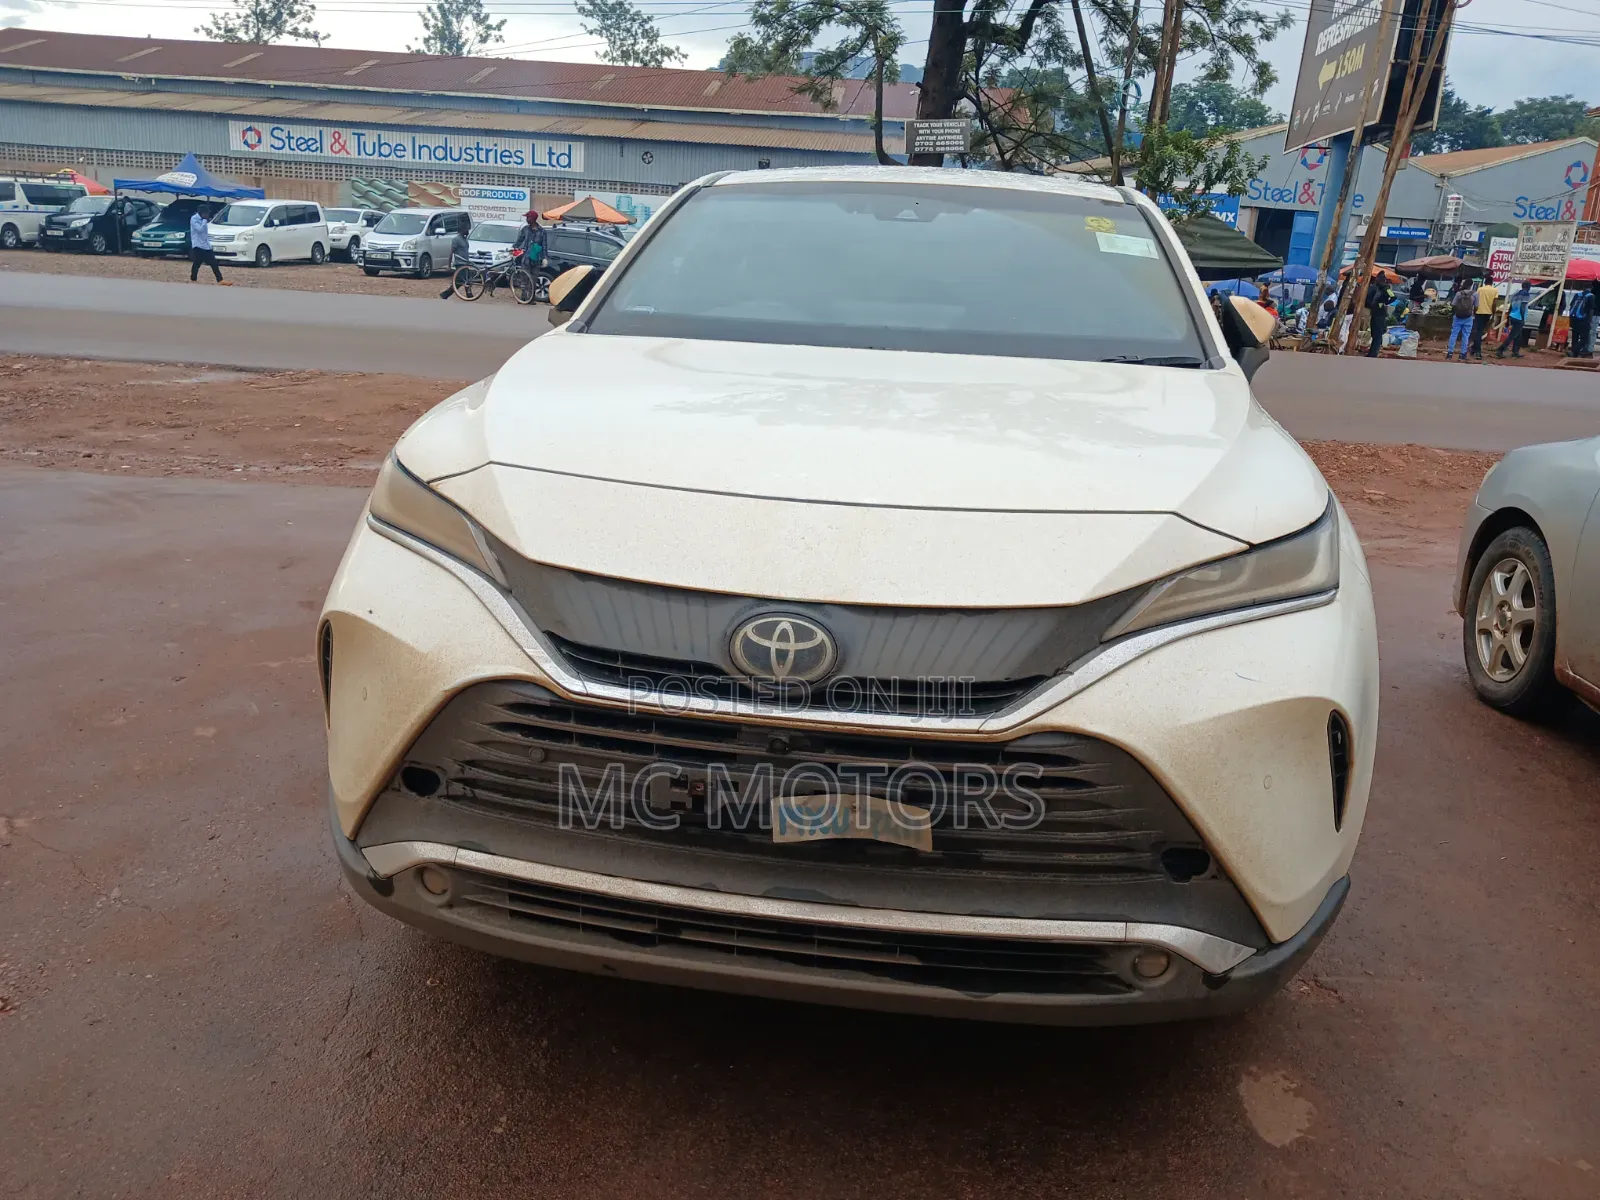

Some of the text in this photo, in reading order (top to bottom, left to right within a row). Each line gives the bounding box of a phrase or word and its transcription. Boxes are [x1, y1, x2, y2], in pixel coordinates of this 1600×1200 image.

[270, 126, 572, 169] Steel & Tube Industries Ltd
[458, 188, 524, 200] ROOF PRODUCTS
[1247, 178, 1299, 204] Steel
[1298, 182, 1317, 206] &
[1512, 196, 1562, 221] Steel
[1492, 262, 1511, 271] ENGI
[1493, 253, 1514, 262] STRU
